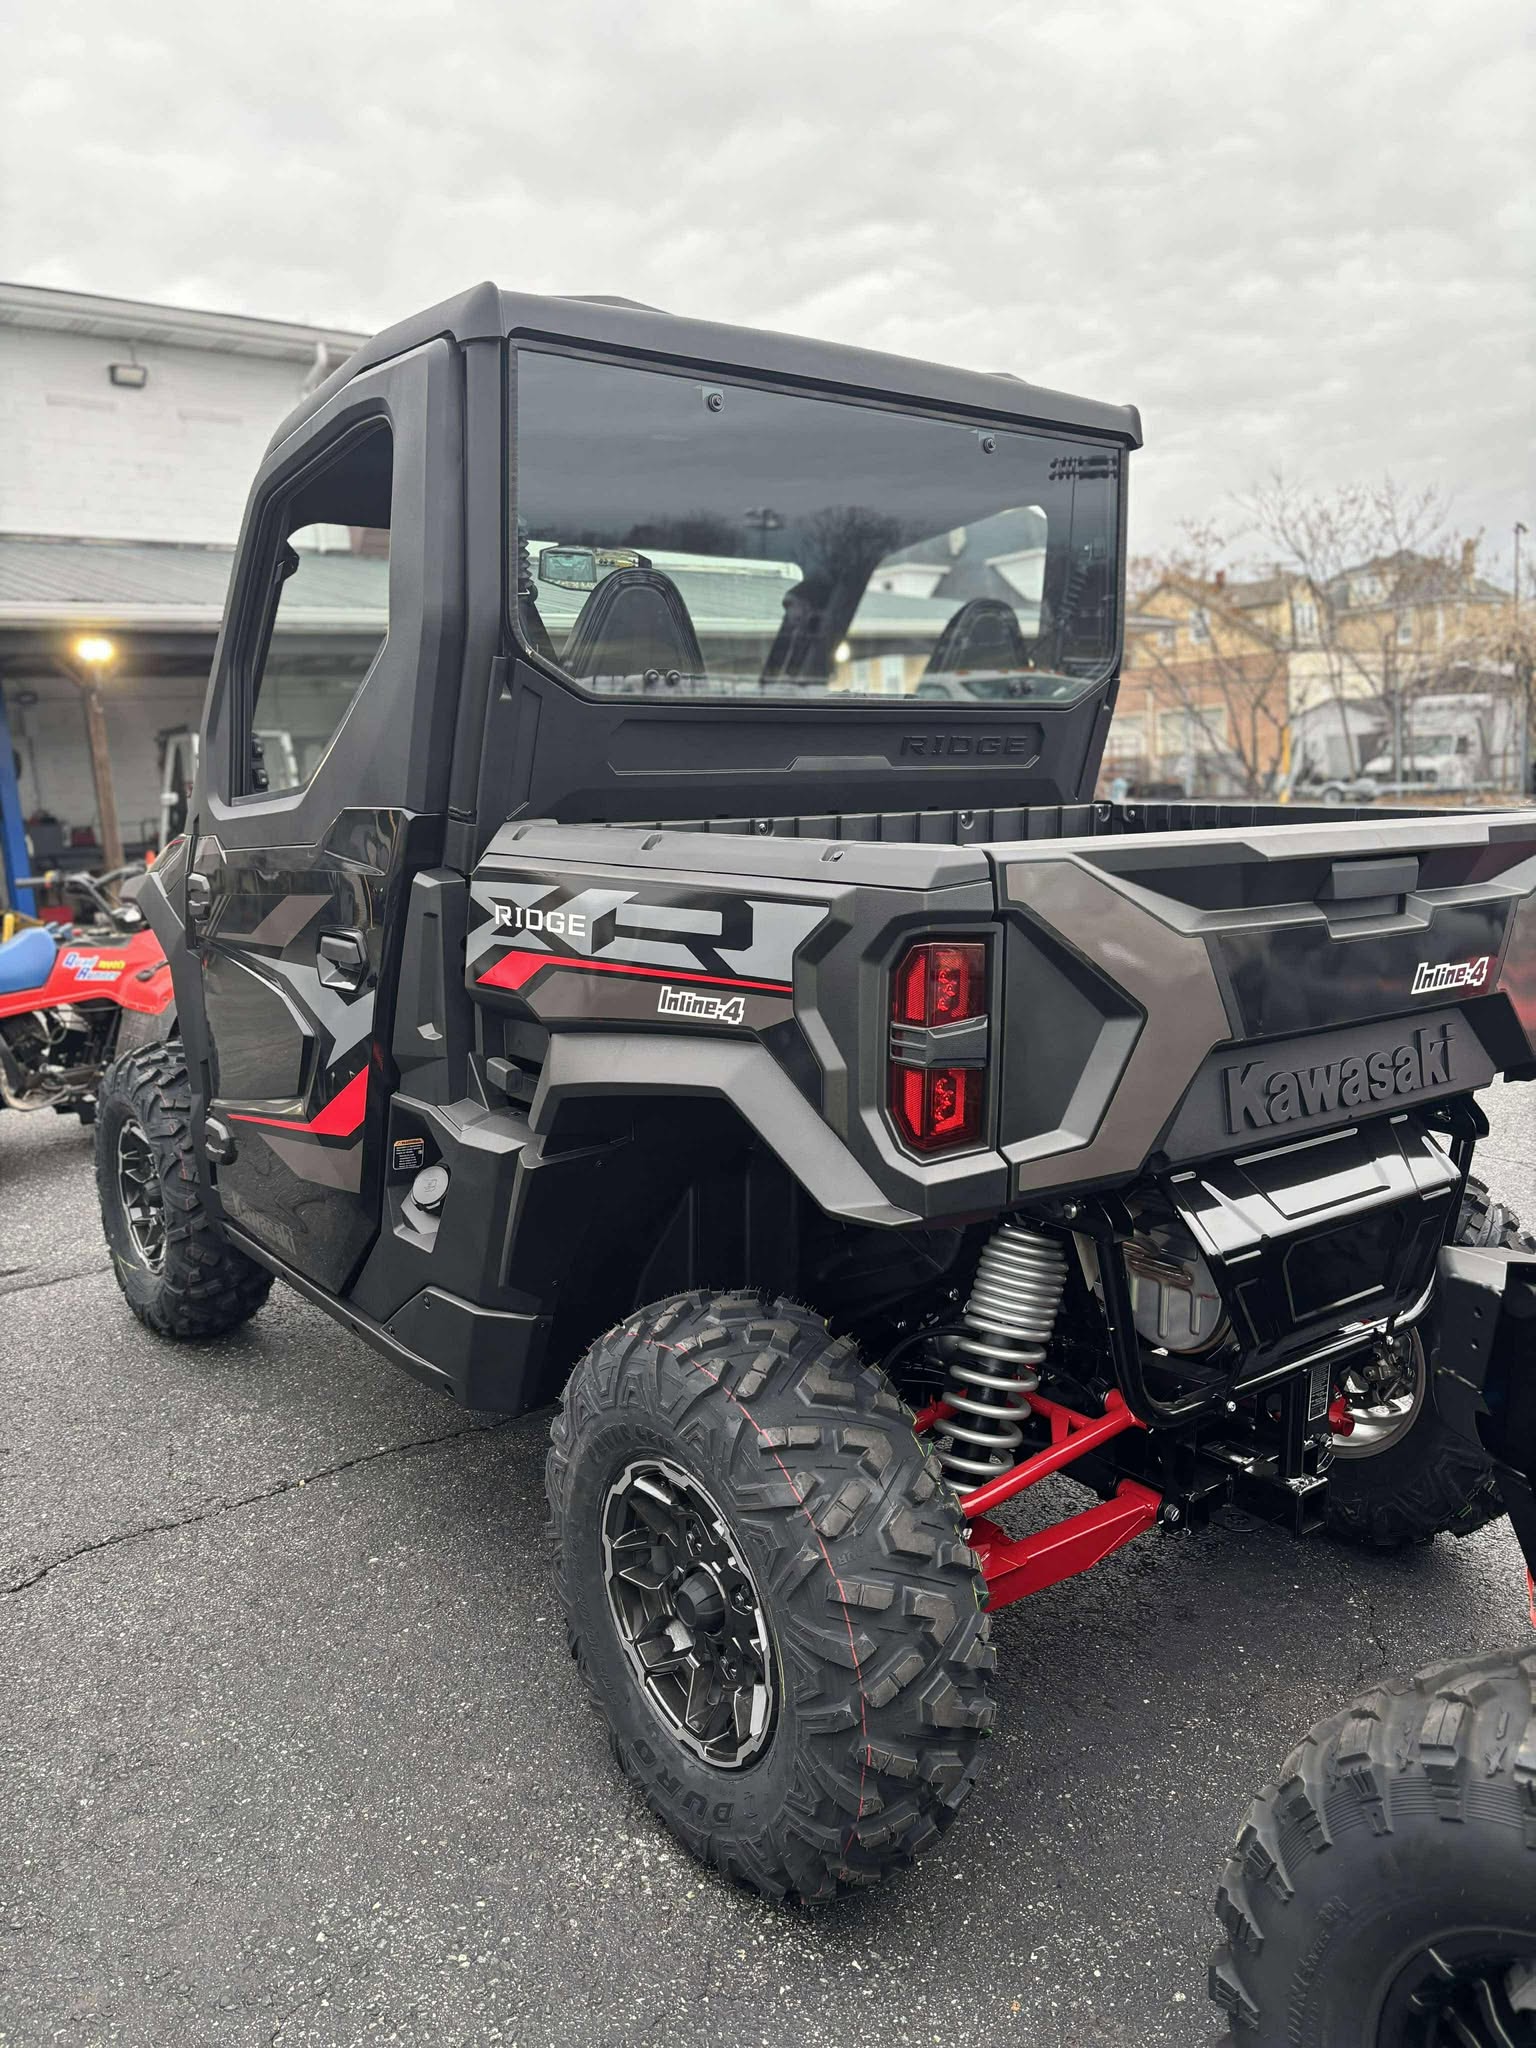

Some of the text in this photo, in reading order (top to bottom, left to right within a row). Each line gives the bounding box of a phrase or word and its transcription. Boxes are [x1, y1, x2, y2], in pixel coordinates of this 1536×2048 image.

[900, 735, 1028, 756] RIDGE
[495, 904, 587, 937] RIDGE
[1411, 956, 1490, 995] Inline-4
[657, 985, 745, 1025] Inline-4
[1223, 1023, 1457, 1134] Kawasaki
[629, 1738, 735, 1827] DURO
